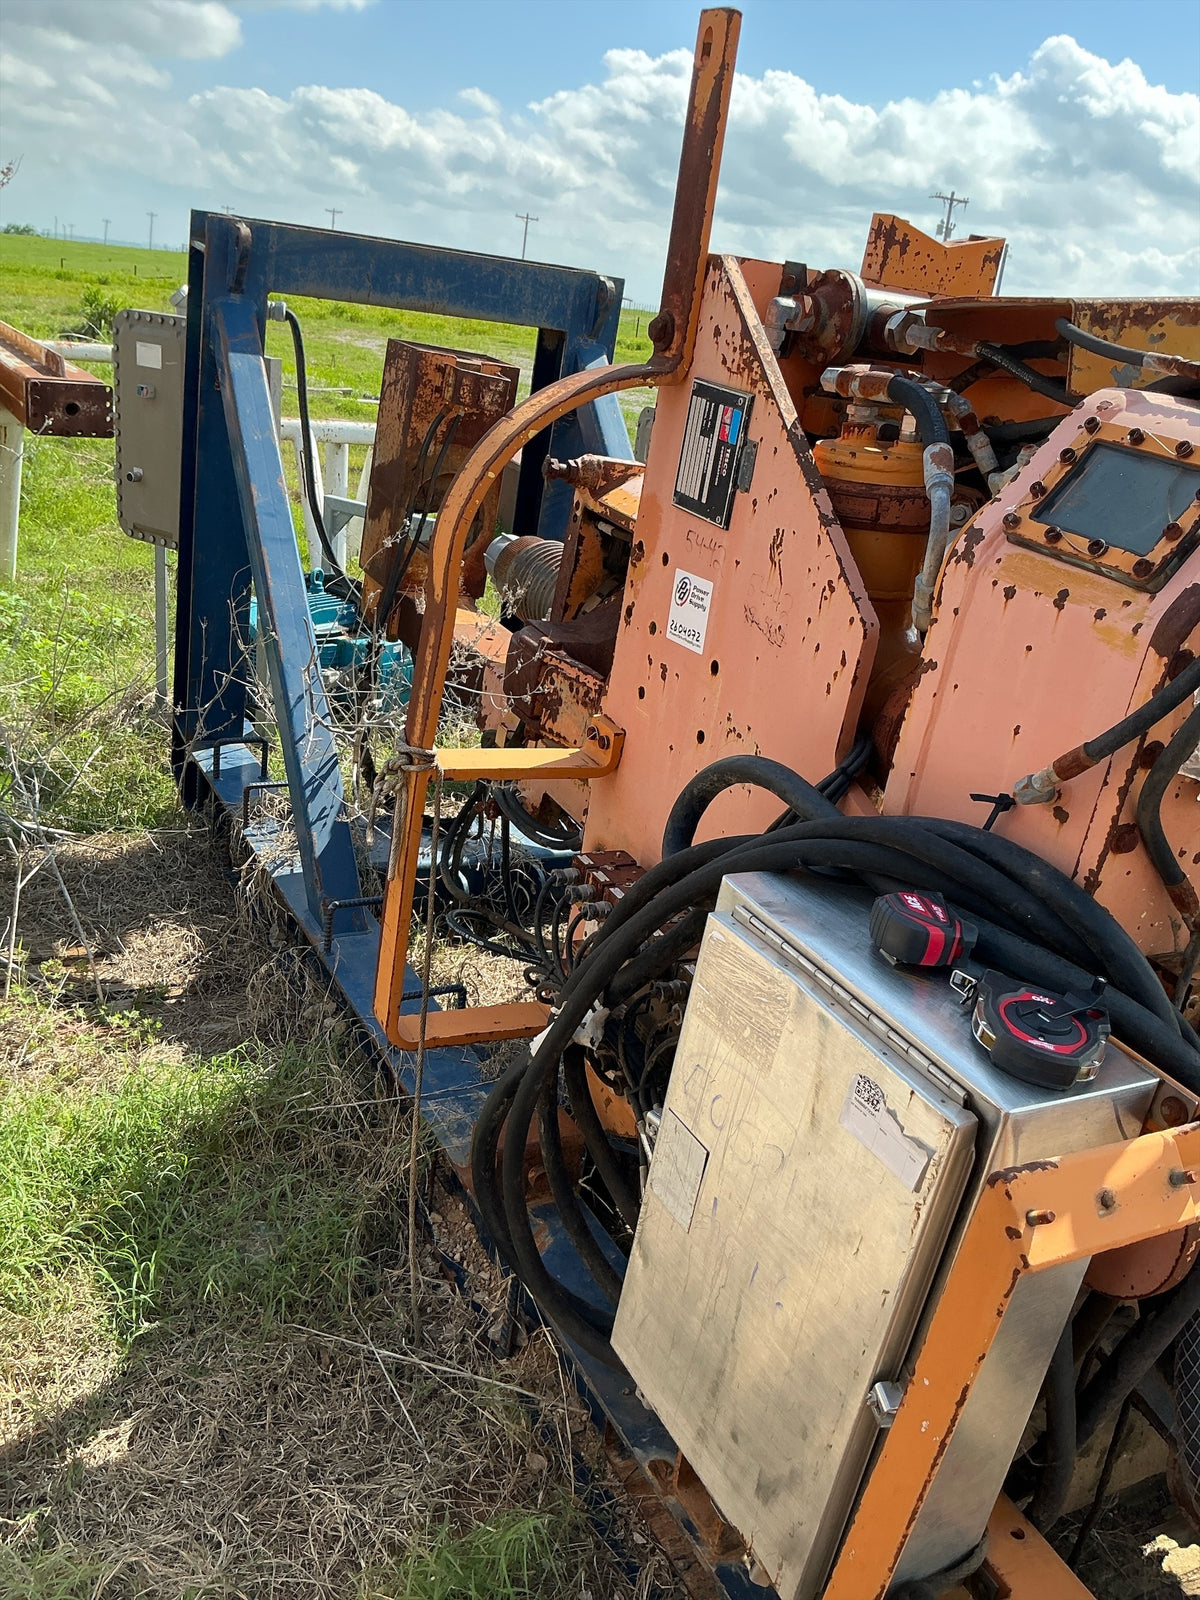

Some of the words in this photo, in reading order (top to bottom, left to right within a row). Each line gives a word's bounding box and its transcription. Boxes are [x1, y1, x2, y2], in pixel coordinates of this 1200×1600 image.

[722, 448, 731, 477] TESCO
[690, 592, 704, 602] Drive
[692, 585, 710, 597] Power
[688, 598, 707, 612] Supply
